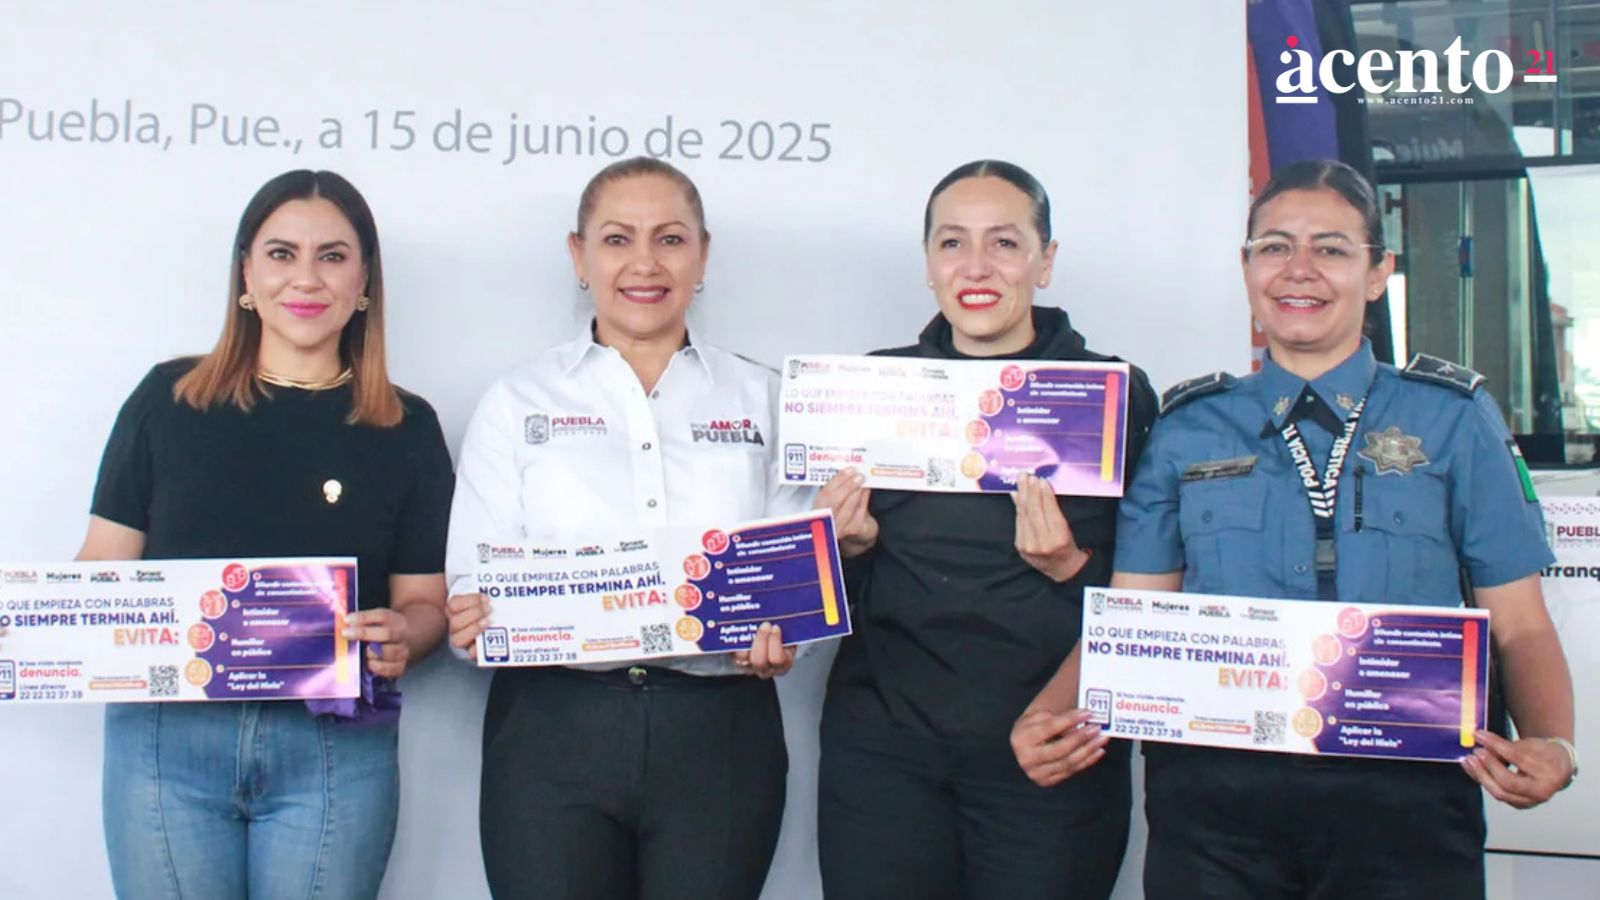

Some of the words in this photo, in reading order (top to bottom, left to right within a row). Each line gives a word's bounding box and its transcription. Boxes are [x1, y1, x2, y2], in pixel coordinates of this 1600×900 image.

[0, 98, 172, 151] Puebla,
[190, 103, 303, 154] Pue.,
[318, 117, 343, 149] a
[364, 109, 416, 151] 15
[432, 108, 492, 153] de
[502, 112, 630, 166] junio
[644, 115, 703, 159] de
[718, 120, 832, 163] 2025
[785, 402, 804, 413] NO
[552, 417, 606, 426] PUEBLA
[710, 419, 751, 430] AMOR
[692, 430, 764, 446] PUEBLA
[788, 453, 803, 461] 911
[47, 572, 82, 581] Mujeres
[478, 573, 493, 583] LO
[496, 573, 520, 583] QUE
[522, 571, 569, 582] EMPIEZA
[572, 569, 598, 580] CON
[601, 561, 660, 577] PALABRAS
[479, 586, 501, 598] NO
[505, 583, 566, 597] SIEMPRE
[569, 579, 633, 595] TERMINA
[637, 571, 666, 589] AHÍ.
[7, 600, 30, 610] QUE
[34, 599, 81, 609] EMPIEZA
[85, 598, 112, 608] CON
[115, 598, 174, 608] PALABRAS
[602, 590, 667, 611] EVITA:
[1152, 600, 1190, 612] Mujeres
[15, 614, 78, 626] SIEMPRE
[80, 612, 146, 625] TERMINA
[150, 609, 179, 624] AHÍ.
[114, 628, 179, 646] EVITA:
[487, 636, 504, 644] 911
[512, 633, 574, 643] denuncia.
[1088, 626, 1105, 637] LO
[1108, 627, 1133, 639] QUE
[1137, 629, 1187, 643] EMPIEZA
[1190, 633, 1219, 645] CON
[1222, 636, 1286, 649] PALABRAS
[1088, 642, 1112, 654] NO
[1115, 643, 1182, 661] SIEMPRE
[1185, 648, 1255, 666] TERMINA
[19, 667, 82, 678] denuncia.
[1218, 667, 1289, 690] EVITA:
[20, 691, 30, 699] 22
[32, 691, 43, 699] 22
[45, 690, 56, 699] 32
[58, 690, 69, 699] 37
[1089, 700, 1107, 710] 911
[1116, 700, 1182, 714] denuncia.
[1115, 725, 1127, 733] 22
[1129, 726, 1140, 734] 22
[1142, 727, 1154, 735] 32
[1156, 728, 1168, 736] 37
[1170, 729, 1182, 737] 38
